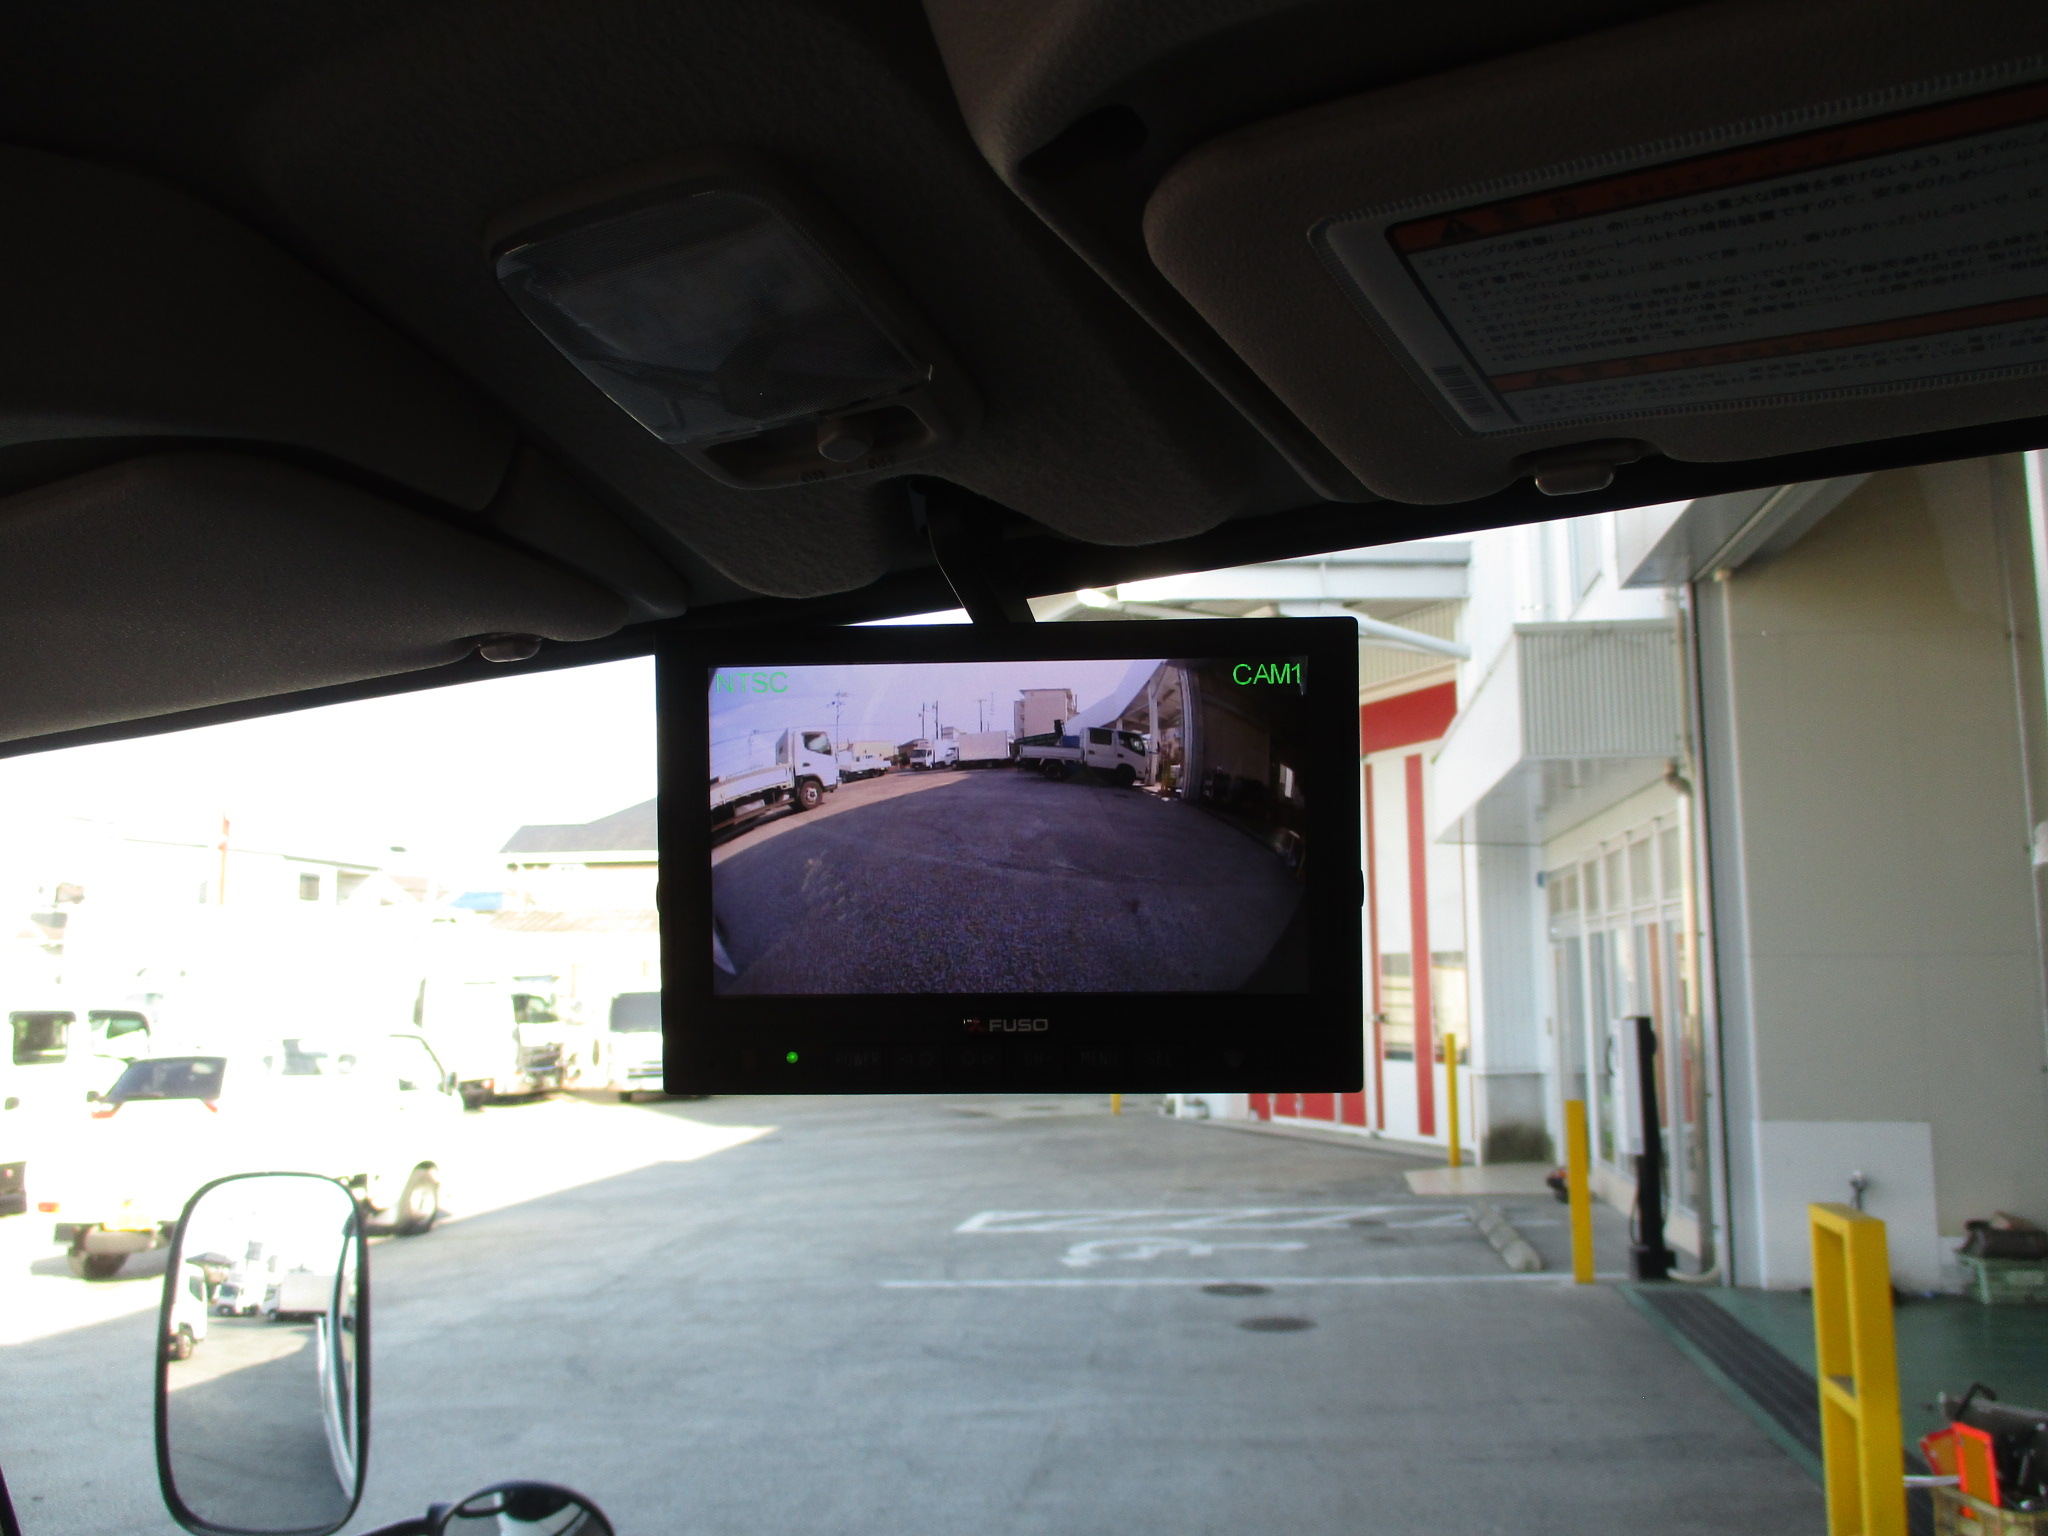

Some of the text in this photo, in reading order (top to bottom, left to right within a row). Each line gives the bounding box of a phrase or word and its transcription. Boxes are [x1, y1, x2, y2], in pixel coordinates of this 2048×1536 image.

[716, 671, 789, 694] NTSC
[1232, 663, 1302, 686] CAM1
[989, 1018, 1049, 1032] FUSO
